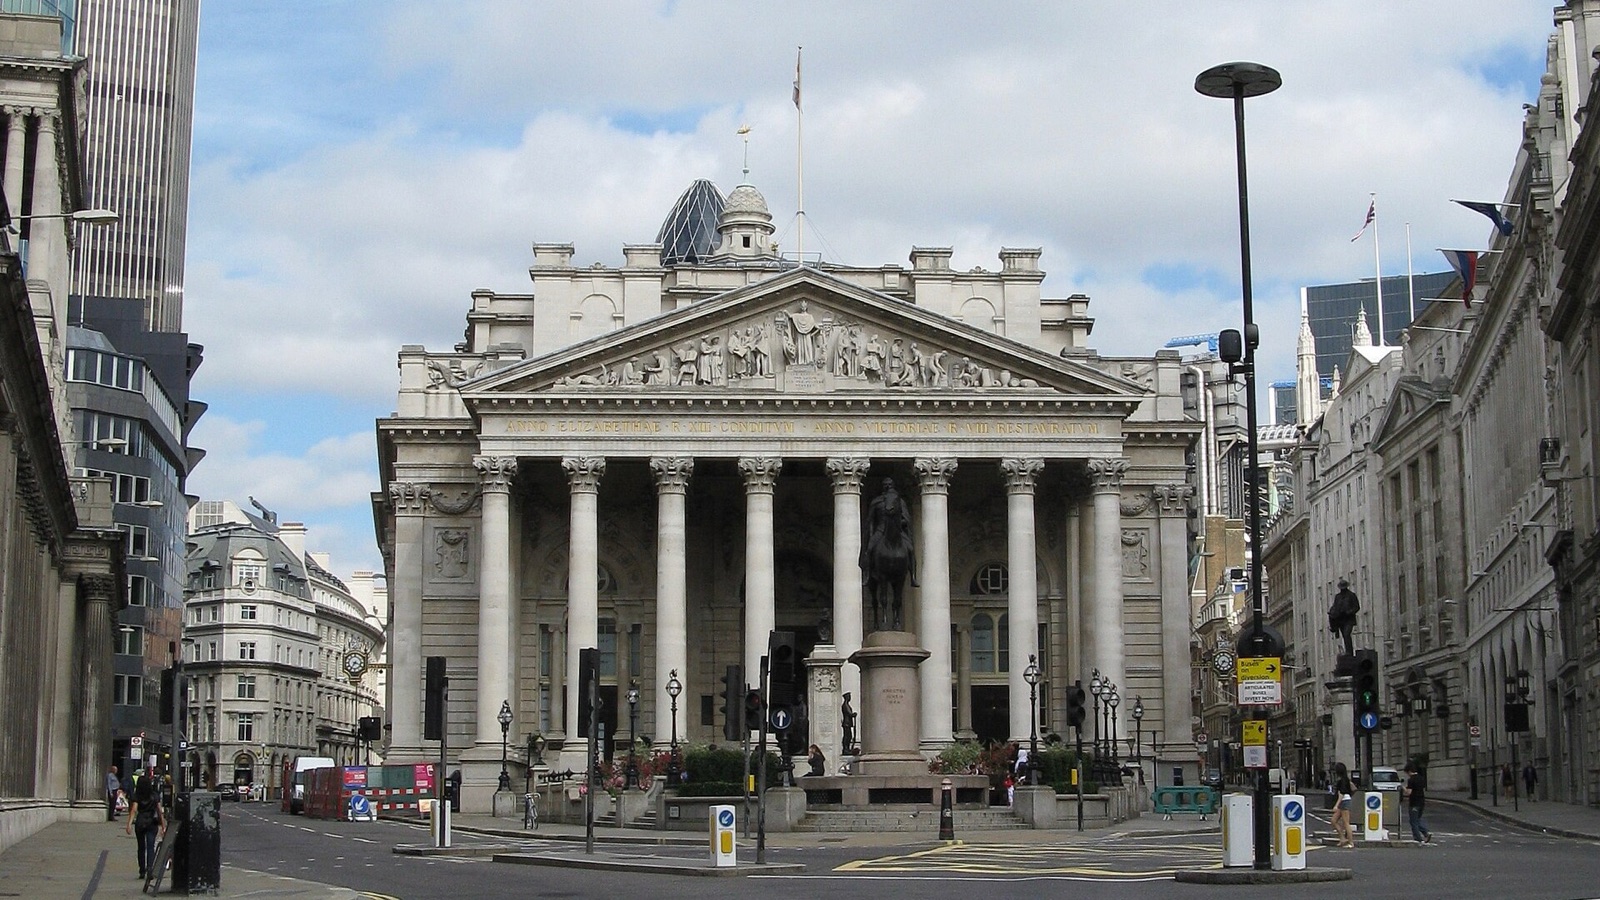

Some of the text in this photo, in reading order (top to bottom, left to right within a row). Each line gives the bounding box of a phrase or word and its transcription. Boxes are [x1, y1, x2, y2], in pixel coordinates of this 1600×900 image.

[506, 420, 1099, 434] ANNO ELIZABETHAE R XIII CONDITVM ANNO VICTORIAE R VIII RESTAVRATVM
